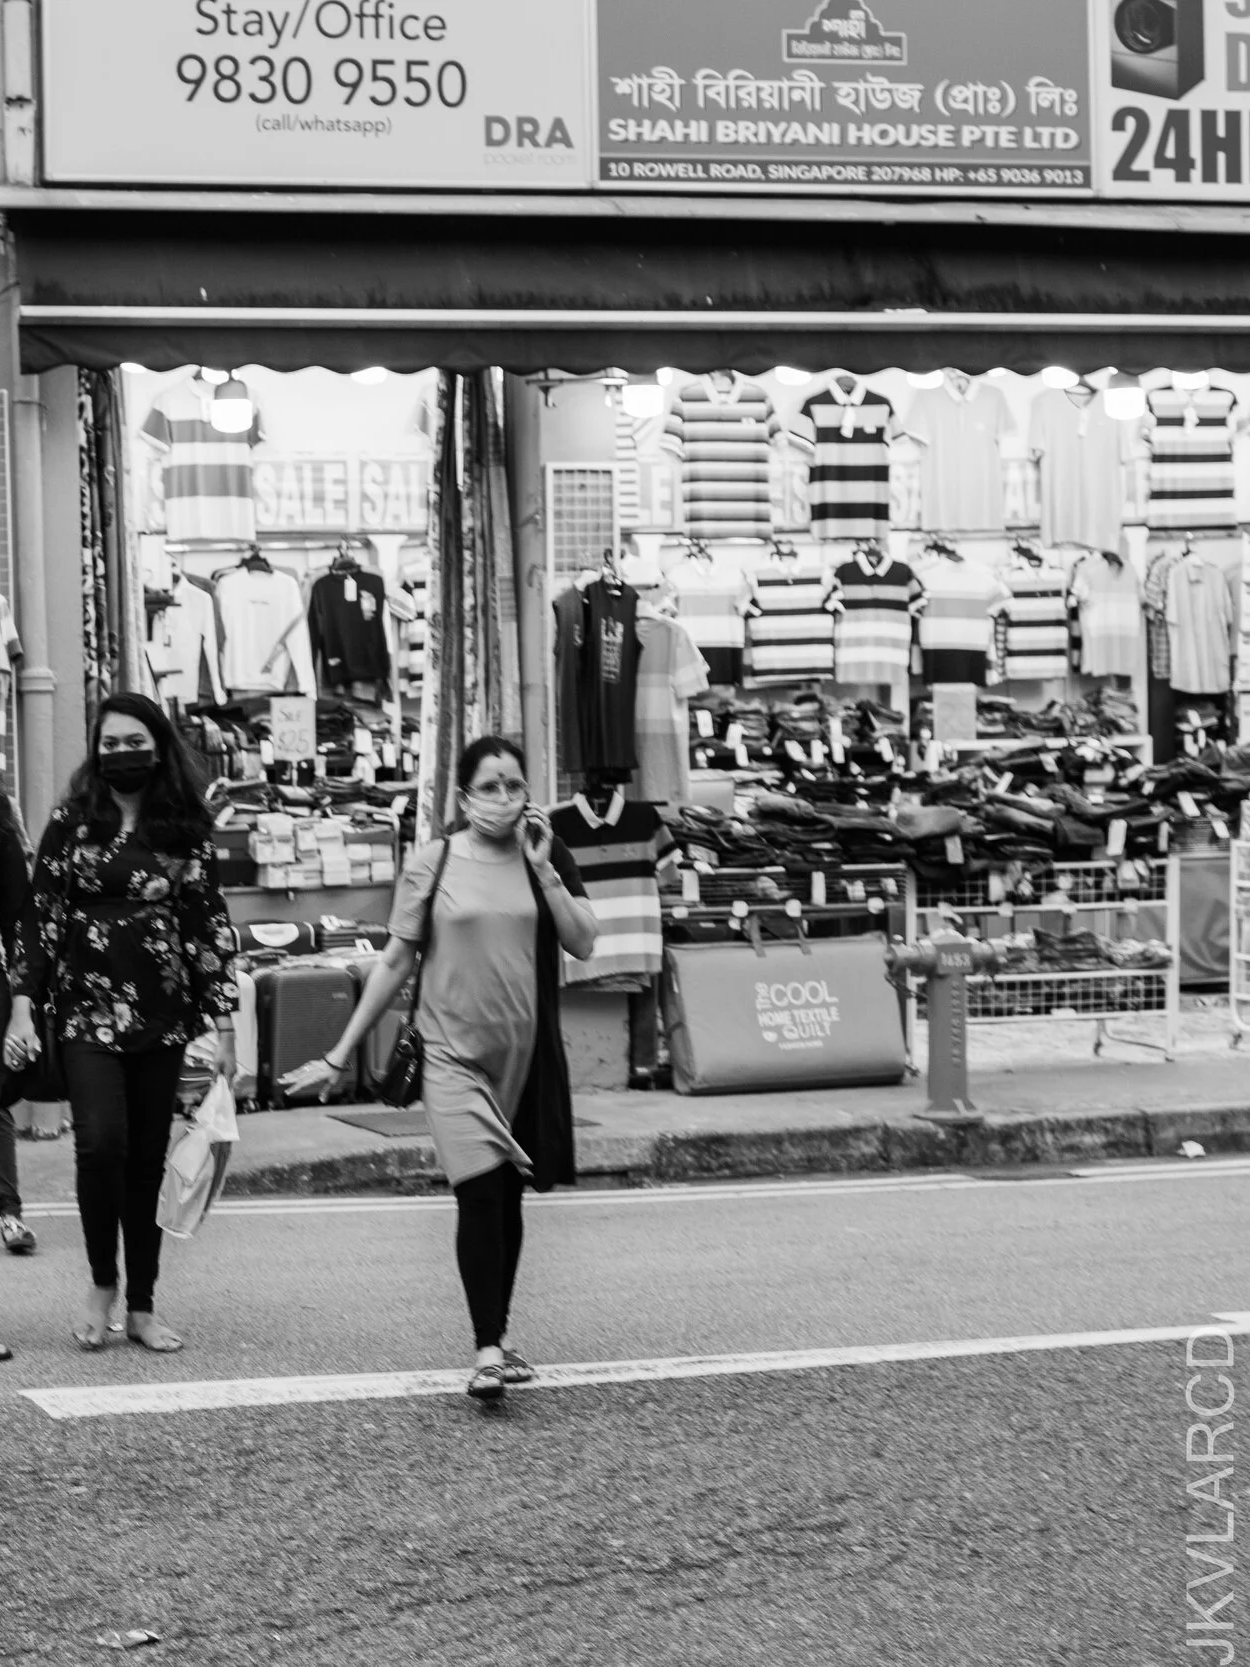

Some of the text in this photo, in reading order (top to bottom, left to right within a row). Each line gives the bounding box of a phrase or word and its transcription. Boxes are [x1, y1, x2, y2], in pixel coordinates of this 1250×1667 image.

[195, 0, 448, 49] Stay/Office
[176, 53, 468, 108] 9830 9550
[608, 66, 687, 112] শাহী
[255, 114, 393, 137] (call/whatsapp)
[483, 115, 575, 148] DRA
[607, 118, 1080, 150] SHAHI BRIYANI HOUSE PTE LTD
[607, 162, 1084, 185] 10 ROWELL ROAD, SINGAPORE 207968 HP: +65 9036 9013
[253, 460, 429, 526] SALE SAL
[770, 979, 839, 1007] COOL
[782, 1021, 831, 1040] QUILT
